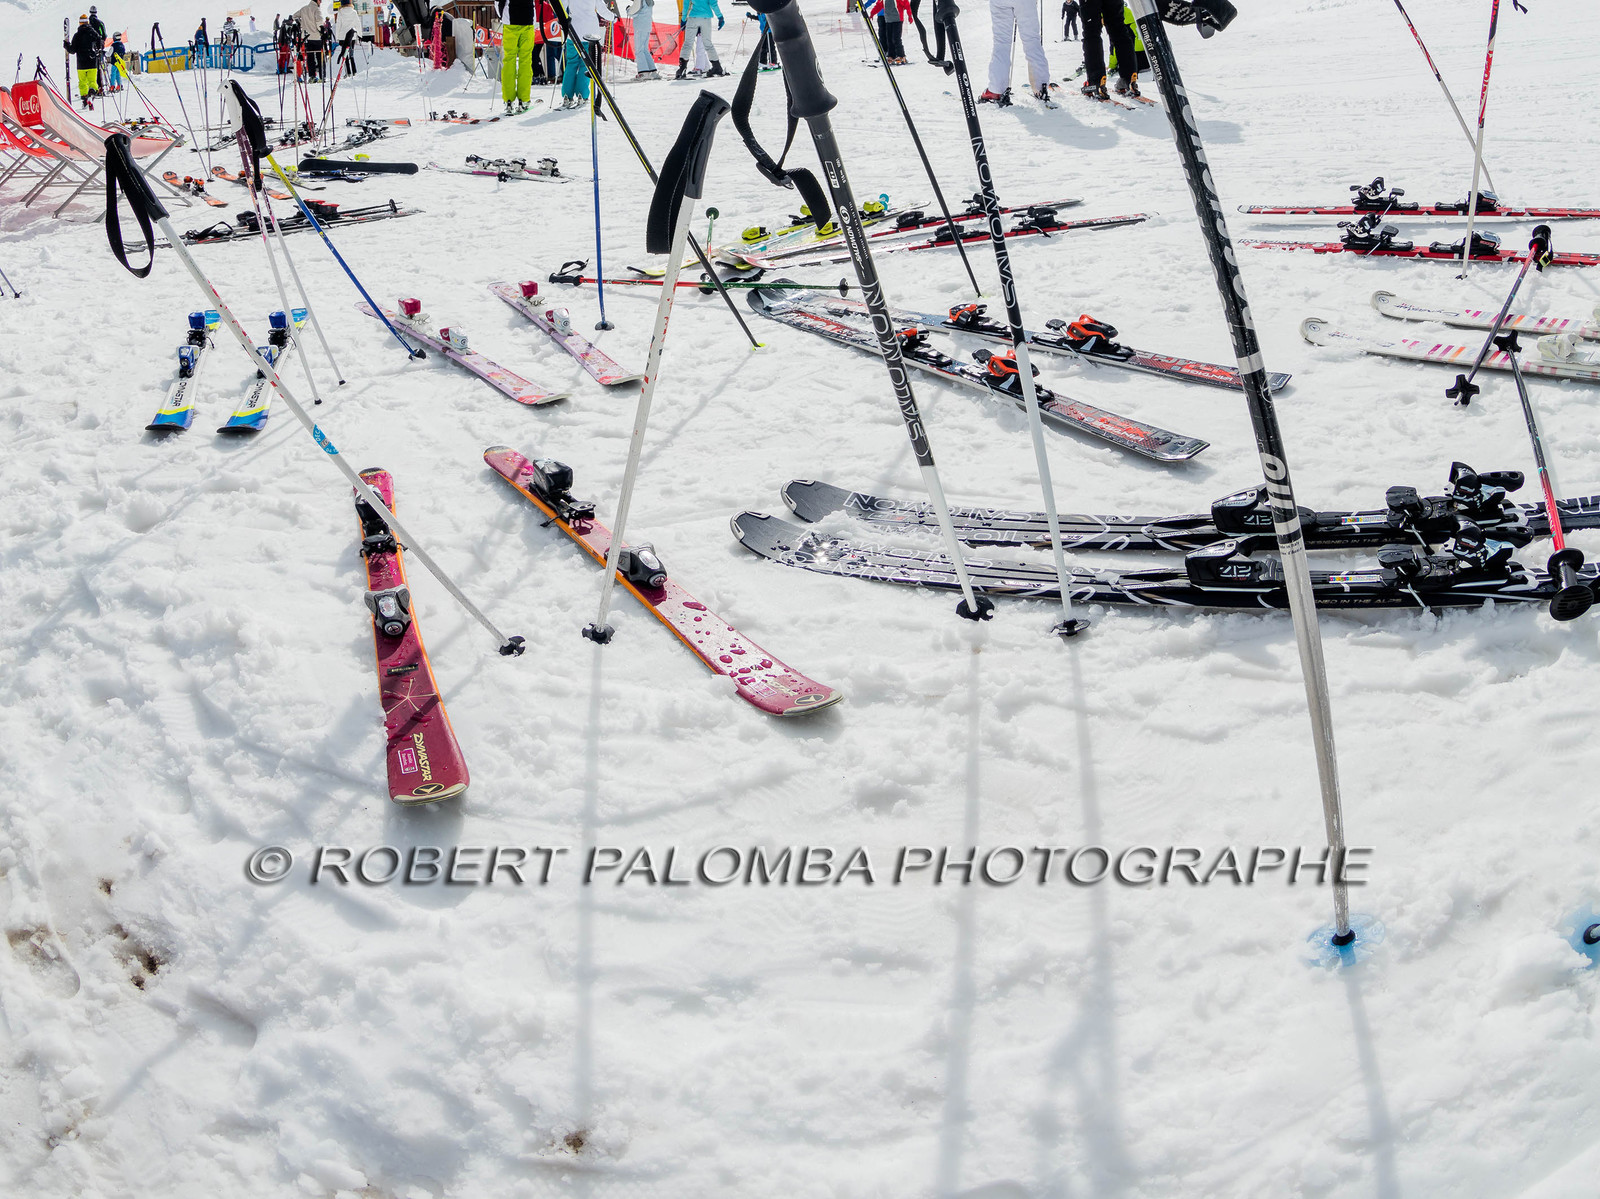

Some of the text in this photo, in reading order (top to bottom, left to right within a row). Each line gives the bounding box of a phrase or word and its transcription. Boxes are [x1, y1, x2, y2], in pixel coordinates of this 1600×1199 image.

[1149, 56, 1164, 81] SPORTS
[844, 224, 863, 262] SALOMON
[413, 731, 433, 782] DYNASTAR
